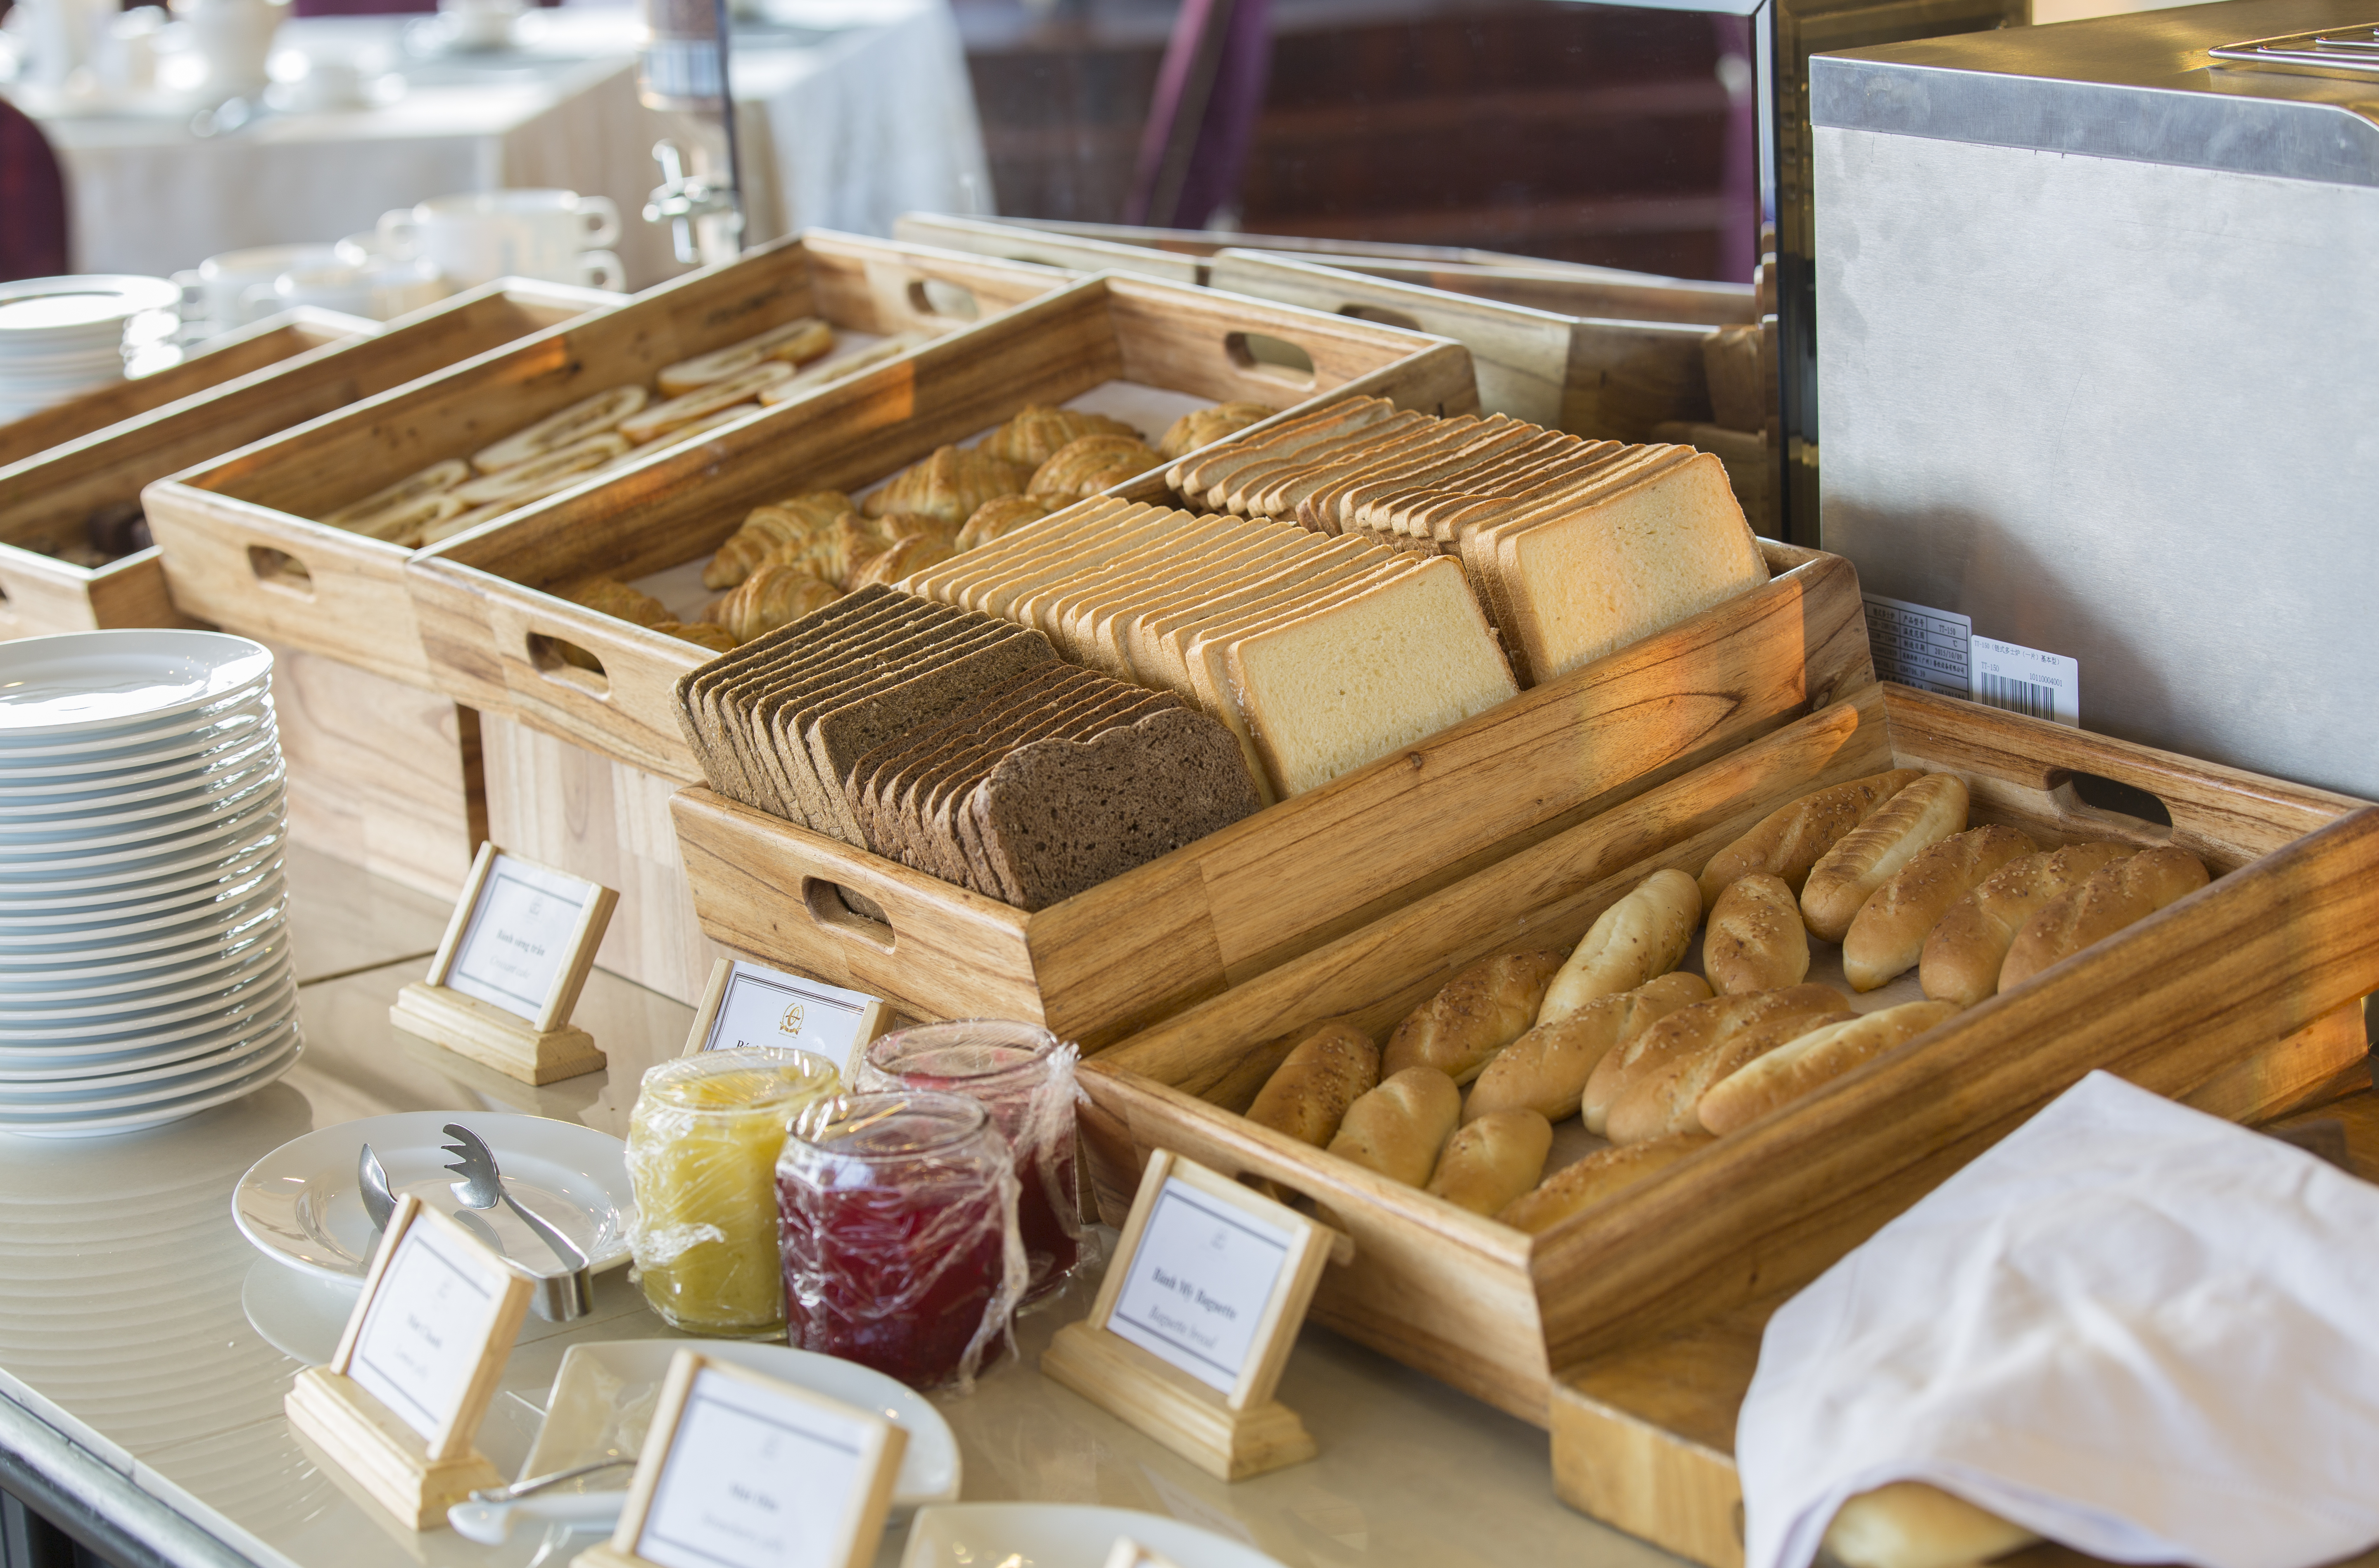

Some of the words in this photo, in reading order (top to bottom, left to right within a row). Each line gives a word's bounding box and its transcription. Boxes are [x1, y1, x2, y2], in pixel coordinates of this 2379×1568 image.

[1903, 615, 1924, 627] 产品型号
[1903, 628, 1925, 639] 温度范围
[1939, 624, 1956, 636] TT-150
[1904, 640, 1925, 652] 制造日期
[1935, 648, 1962, 660] 2015/10/09
[1981, 662, 1999, 672] TT-150
[2030, 673, 2062, 687] 10110004001
